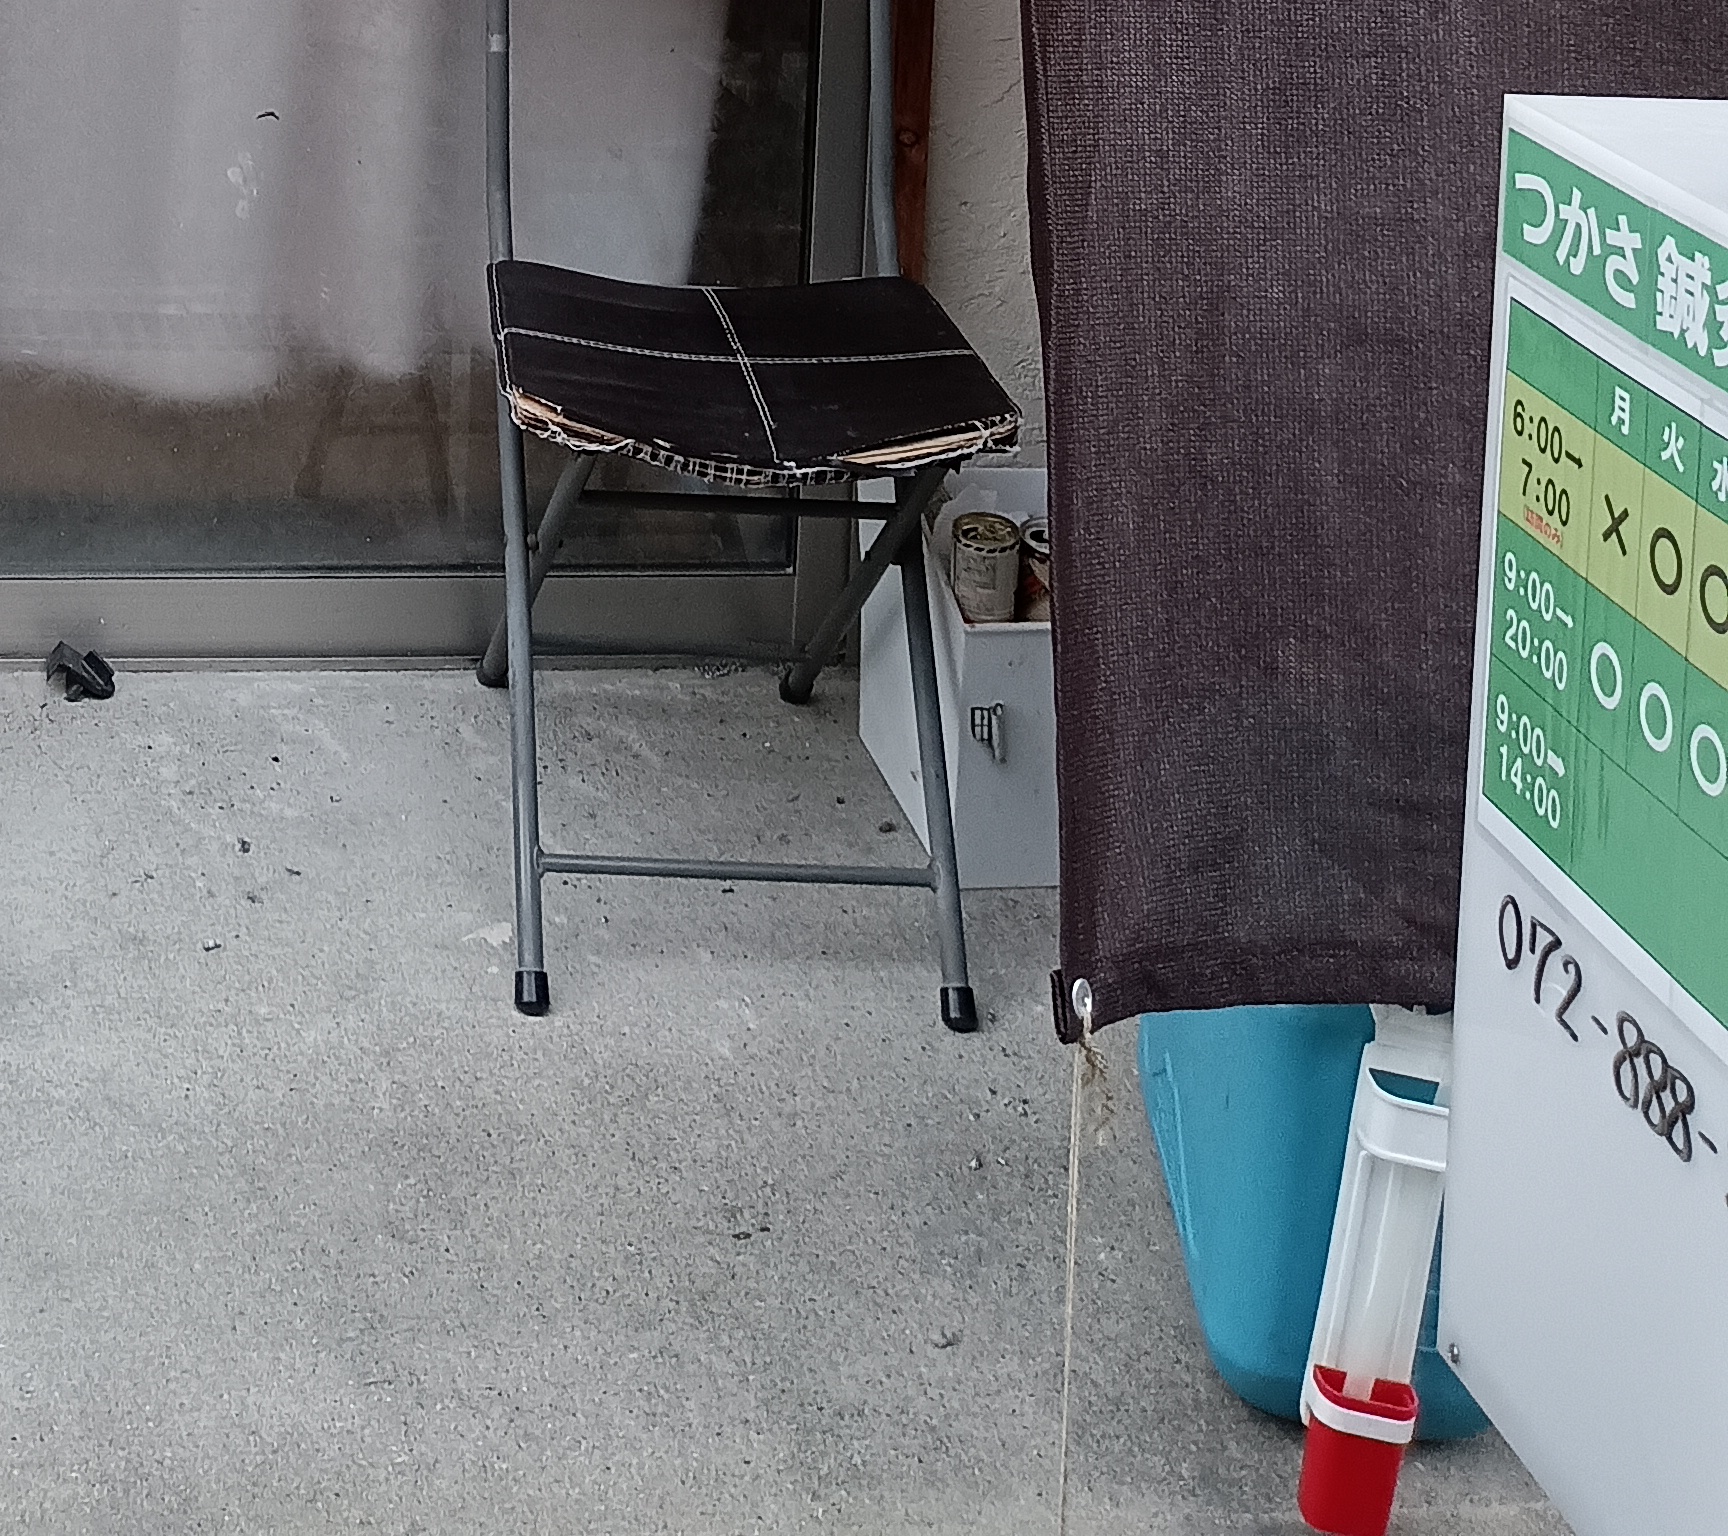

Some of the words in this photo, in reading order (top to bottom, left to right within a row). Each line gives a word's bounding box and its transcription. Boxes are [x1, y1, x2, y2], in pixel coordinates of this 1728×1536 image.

[1610, 384, 1631, 436] 月
[1660, 420, 1685, 473] 火
[1521, 457, 1571, 527] 7:00
[1504, 608, 1568, 691] 20:00
[1499, 744, 1561, 829] 14:00
